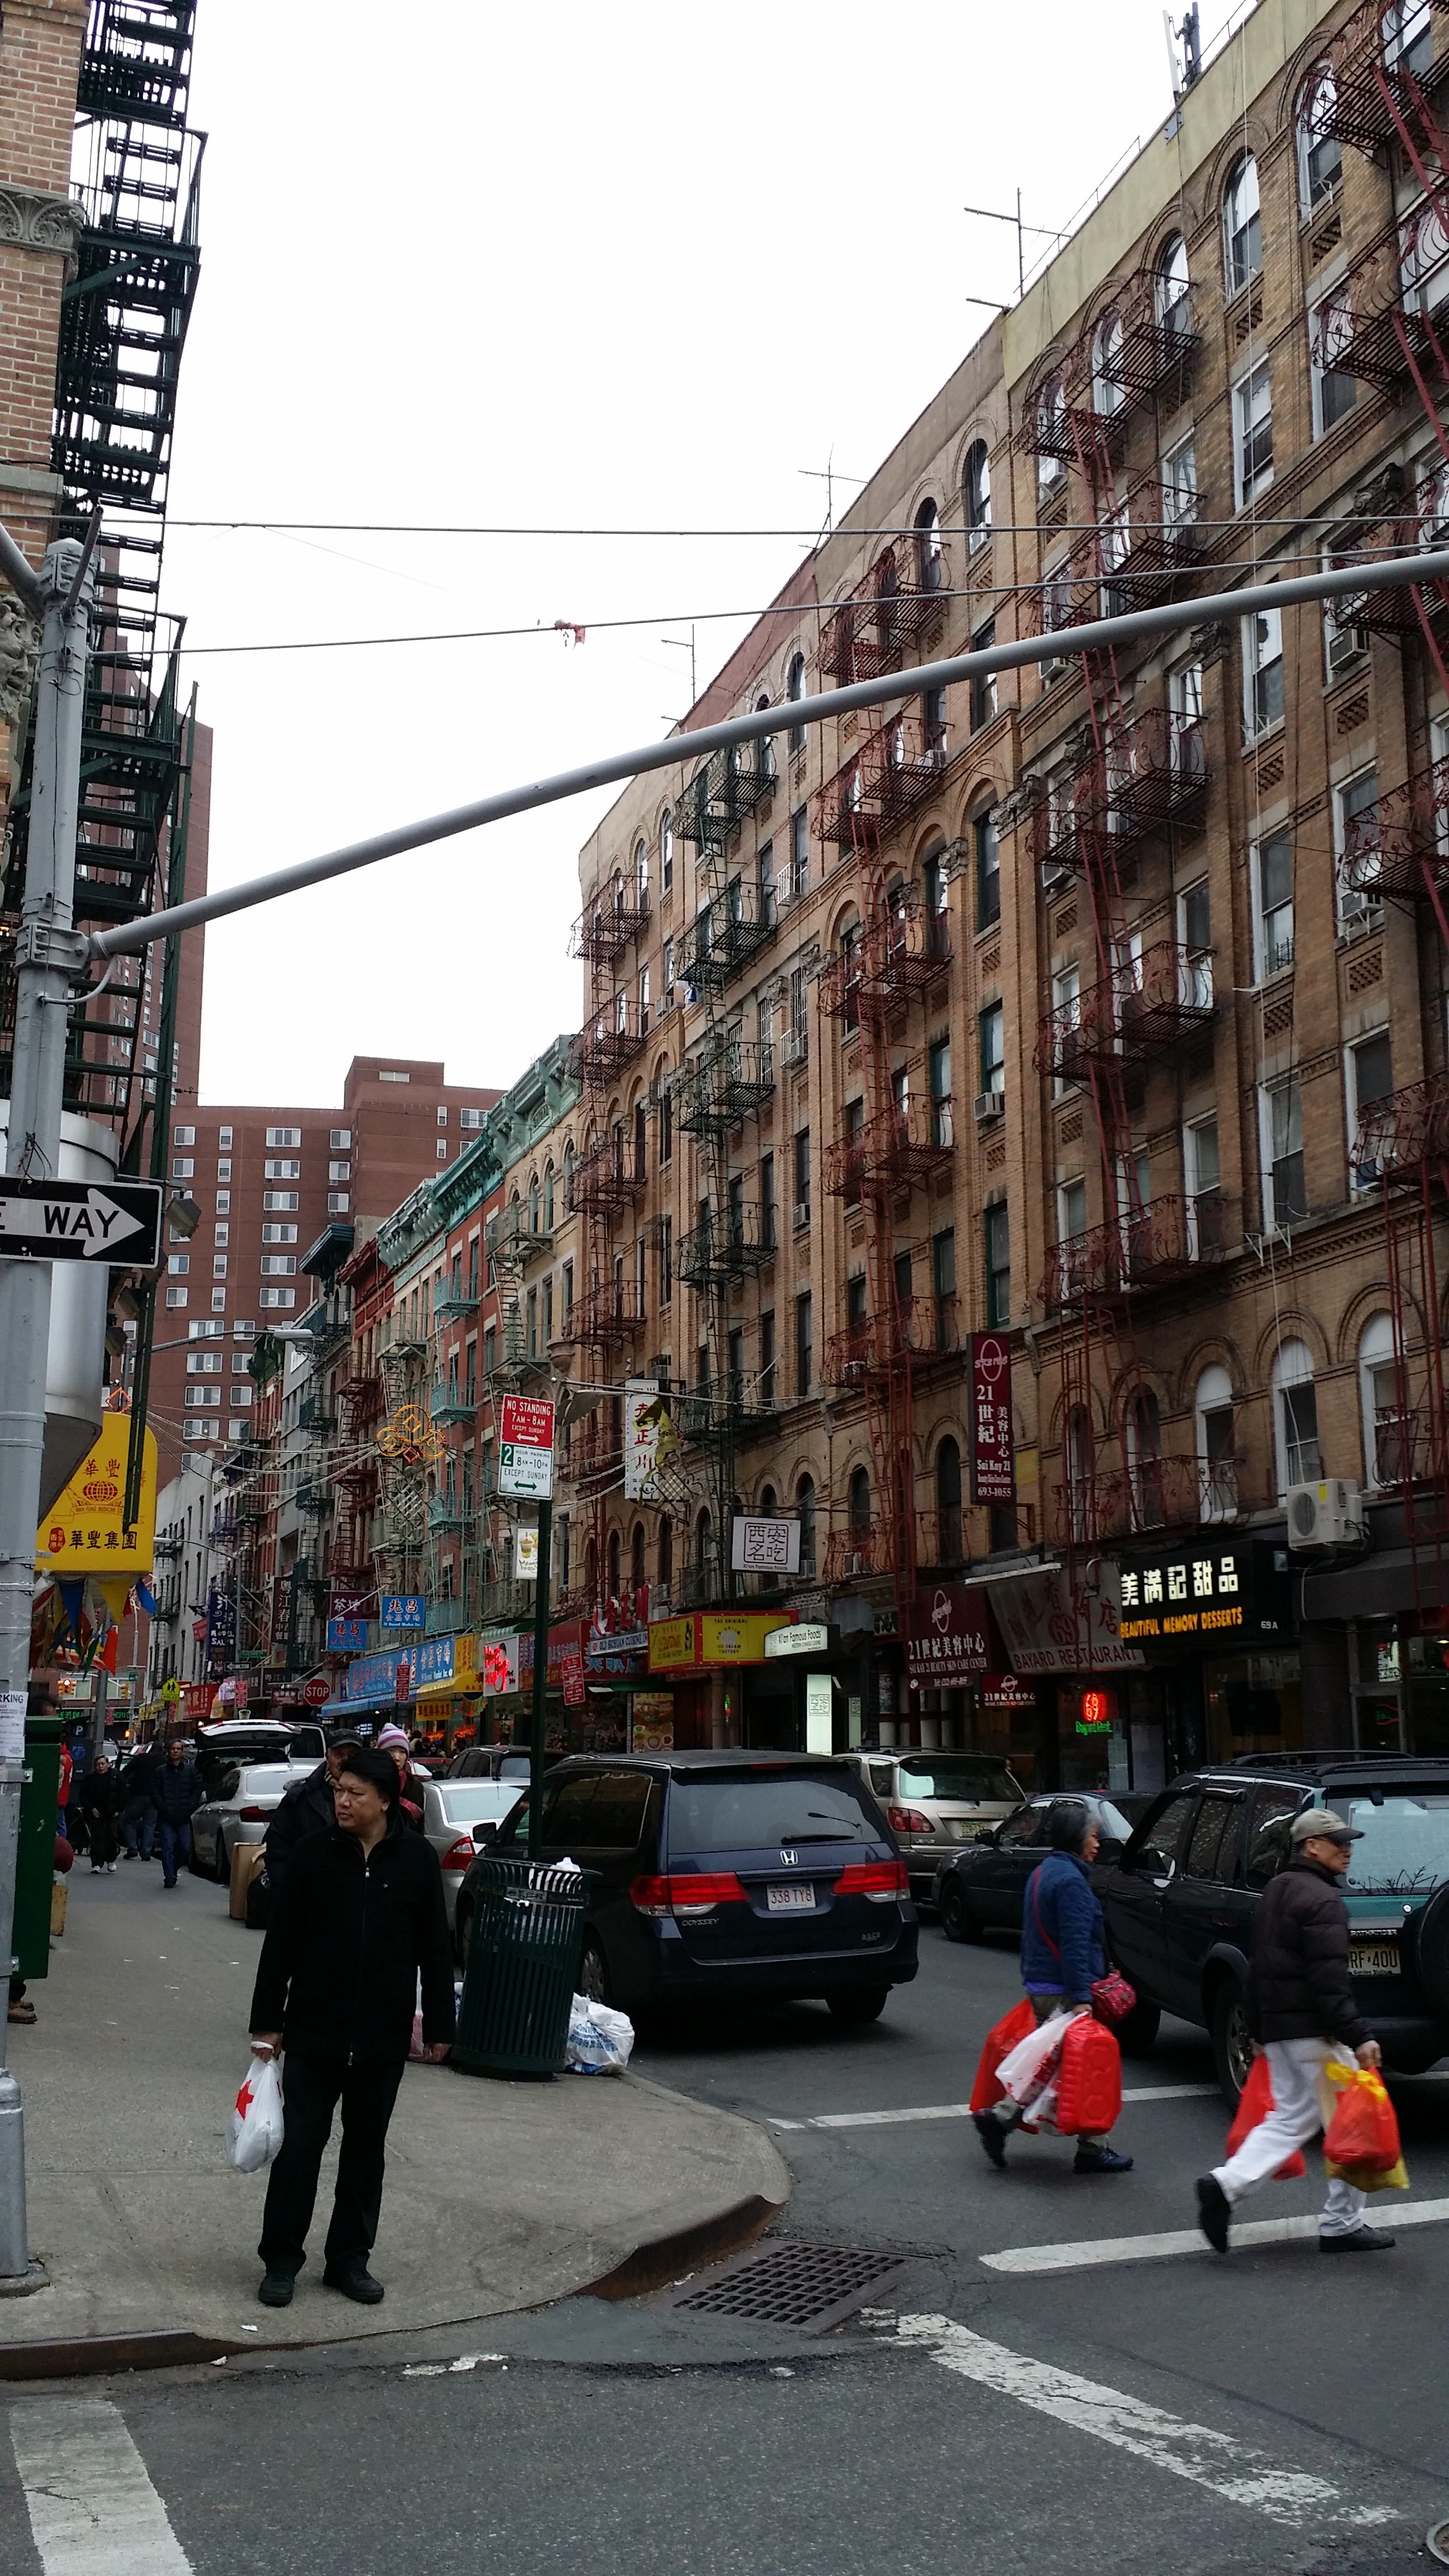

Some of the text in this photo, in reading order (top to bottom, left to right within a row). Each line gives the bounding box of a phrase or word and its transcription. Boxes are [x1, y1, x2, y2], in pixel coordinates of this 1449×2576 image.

[44, 1205, 120, 1238] WAY
[507, 1400, 551, 1416] NO STANDING
[512, 1424, 545, 1434] EXCEPT SUNDAY
[997, 1406, 1010, 1458] 美容中心
[504, 1445, 512, 1465] 2
[504, 1468, 547, 1480] EXCEPT SUNDAY
[1003, 1460, 1011, 1471] 21
[977, 1486, 1012, 1498] 693-1055
[69, 1530, 137, 1550] 華豐集團
[748, 1525, 786, 1544] 西安
[747, 1543, 785, 1562] 名吃
[1120, 1606, 1243, 1639] BEAUTIFUL MEMORY DESSERTS
[789, 1632, 807, 1642] Famous
[807, 1629, 821, 1639] Foods
[908, 1632, 985, 1660] 21世紀美容中心
[1013, 1645, 1137, 1669] BAYARD RESTAURANT
[306, 1687, 329, 1697] STOP
[770, 1889, 812, 1904] 338 TY8
[681, 1918, 720, 1927] ODYSSEY
